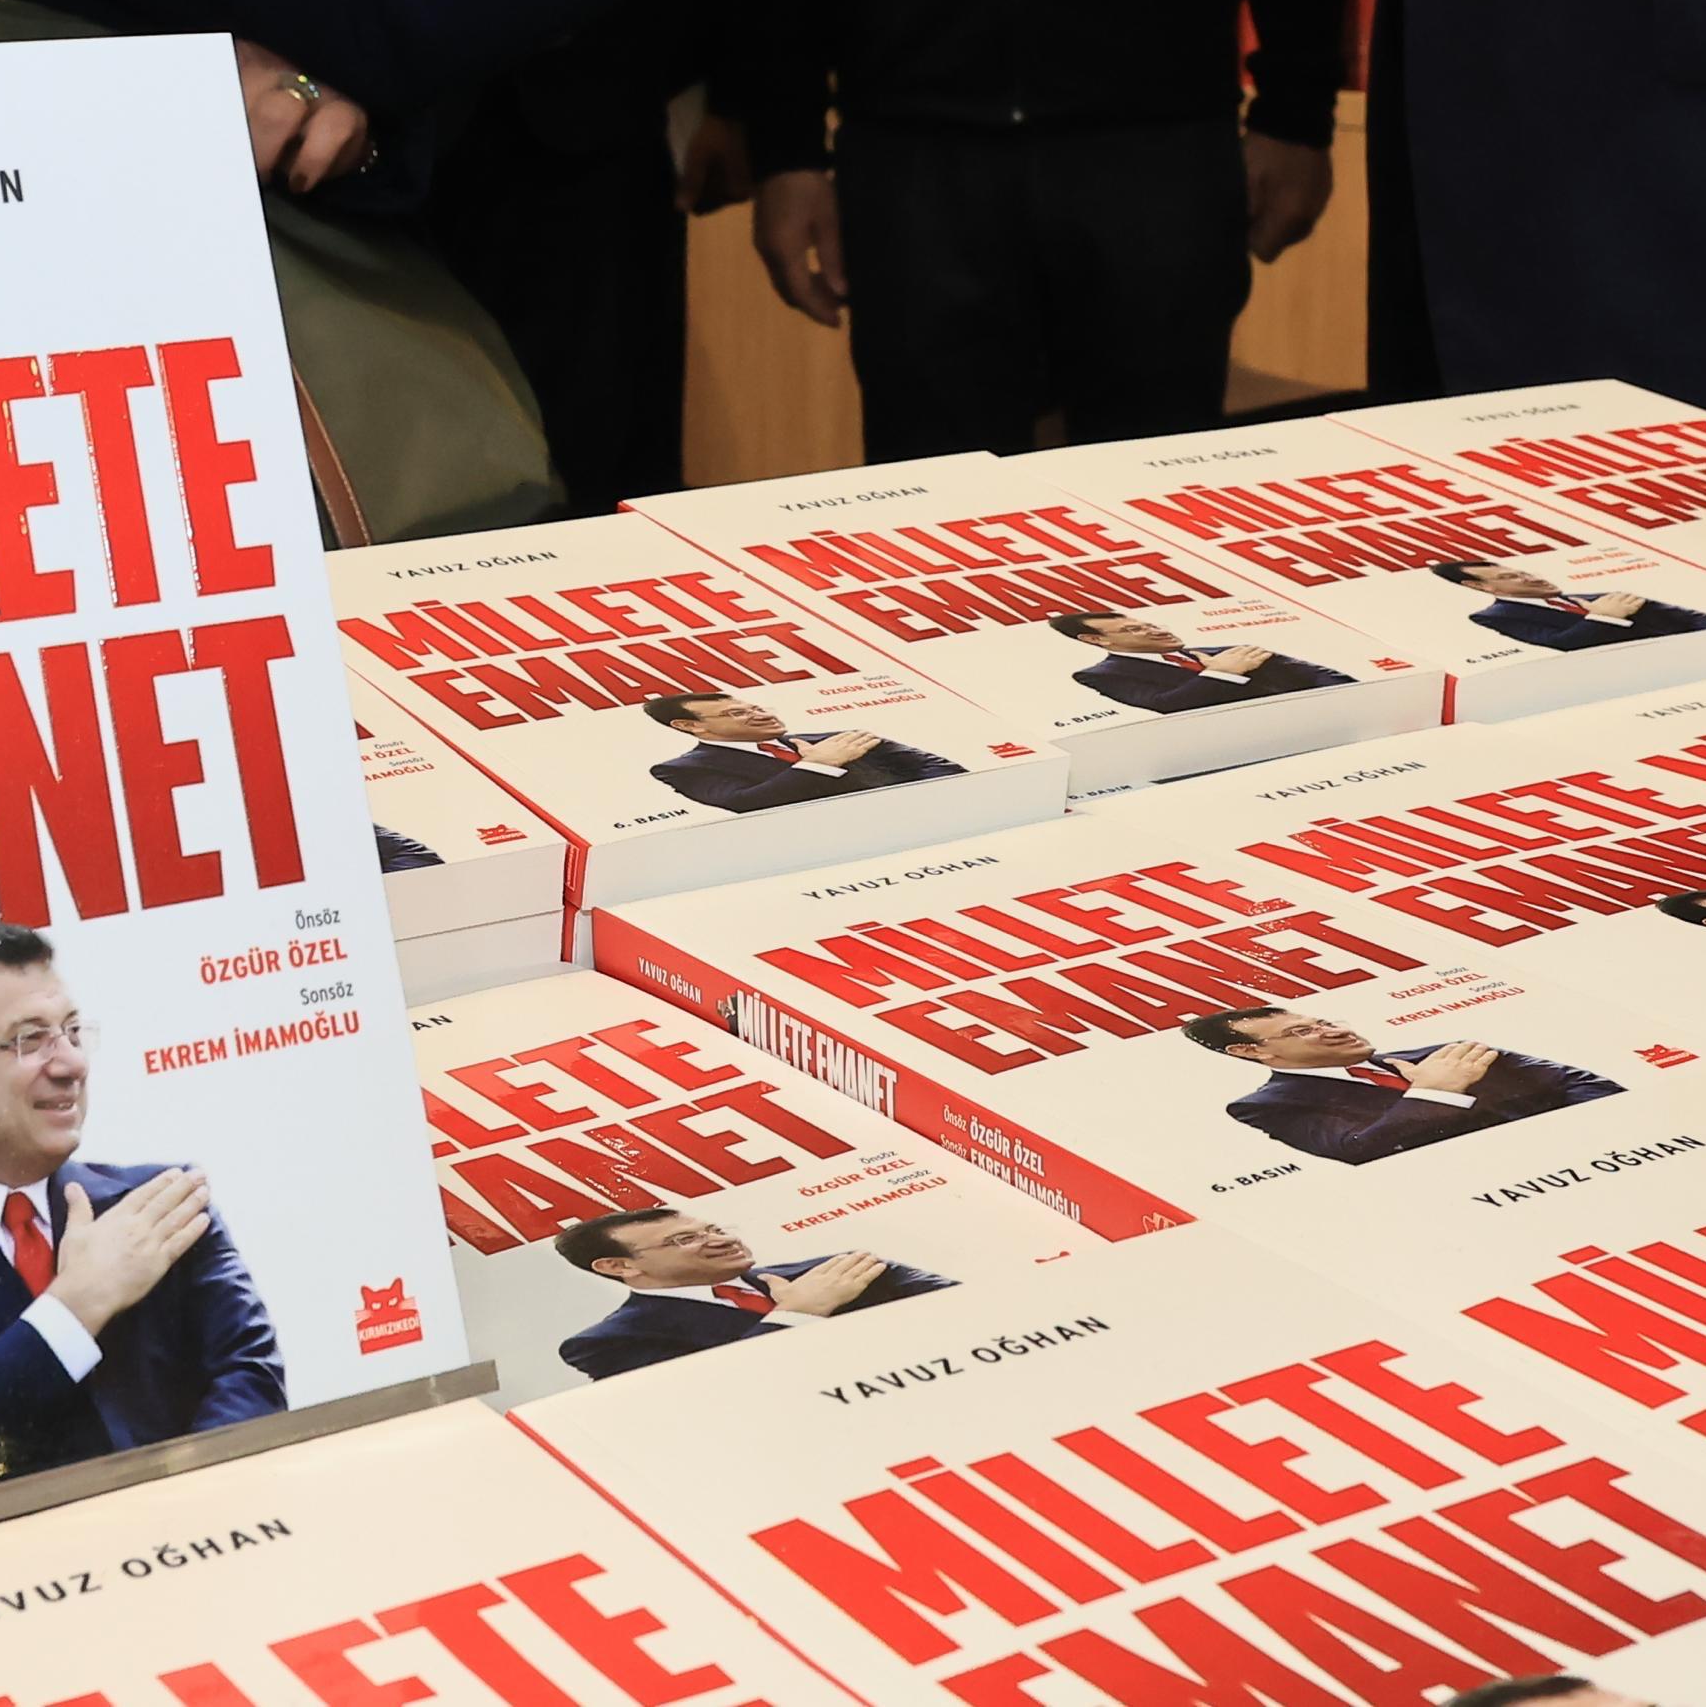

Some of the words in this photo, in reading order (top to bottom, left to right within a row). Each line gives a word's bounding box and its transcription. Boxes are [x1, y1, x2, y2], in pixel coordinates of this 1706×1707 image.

[779, 497, 851, 512] YAVUZ
[857, 485, 929, 504] OĞHAN
[1123, 464, 1492, 540] MİLLETE
[388, 562, 470, 579] YAVUZ
[477, 551, 558, 569] OĞHAN
[742, 505, 1143, 591] MİLLETE
[1216, 505, 1591, 588] EMANET
[337, 572, 778, 671] MİLLETE
[826, 551, 1234, 643] EMANET
[407, 621, 861, 731] EMANET
[1635, 698, 1706, 721] YAVUZ
[1255, 776, 1340, 803] YAVUZ
[1341, 760, 1428, 789] OĞHAN
[633, 809, 690, 827] BASIM
[802, 869, 899, 900] YAVUZ
[903, 855, 1001, 884] OĞHAN
[295, 907, 342, 930] Önsöz
[753, 860, 1295, 1010] MİLLETE
[199, 946, 281, 987] ÖZGÜR
[287, 935, 349, 969] ÖZEL
[637, 955, 669, 987] YAVUZ
[668, 967, 703, 1006] OĞHAN
[1388, 976, 1441, 1000] ÖZGÜR
[1444, 969, 1488, 988] ÖZEL
[300, 980, 354, 1006] Sonsöz
[875, 910, 1431, 1076] EMANET
[1385, 1003, 1441, 1027] EKREM
[1443, 985, 1526, 1014] İMAMOĞLU
[143, 1037, 229, 1075] EKREM
[234, 1009, 362, 1059] İMAMOĞLU
[736, 988, 815, 1079] MİLLETE
[815, 1037, 899, 1118] EMANET
[969, 1112, 1012, 1160] ÖZGÜR
[1012, 1135, 1046, 1179] ÖZEL
[1235, 1163, 1302, 1190] BASIM
[1472, 1165, 1583, 1209] YAVUZ
[1591, 1132, 1704, 1177] OĞHAN
[781, 1202, 843, 1234] EKREM
[846, 1174, 948, 1216] İMAMOĞLU
[799, 1167, 860, 1199] ÖZGÜR
[864, 1155, 915, 1179] ÖZEL
[1011, 1162, 1082, 1224] İMAMOĞLU
[820, 1357, 964, 1407] YAVUZ
[983, 1316, 1110, 1365] OĞHAN
[748, 1340, 1566, 1666] MİLLETE
[120, 1517, 290, 1581] OĞHAN
